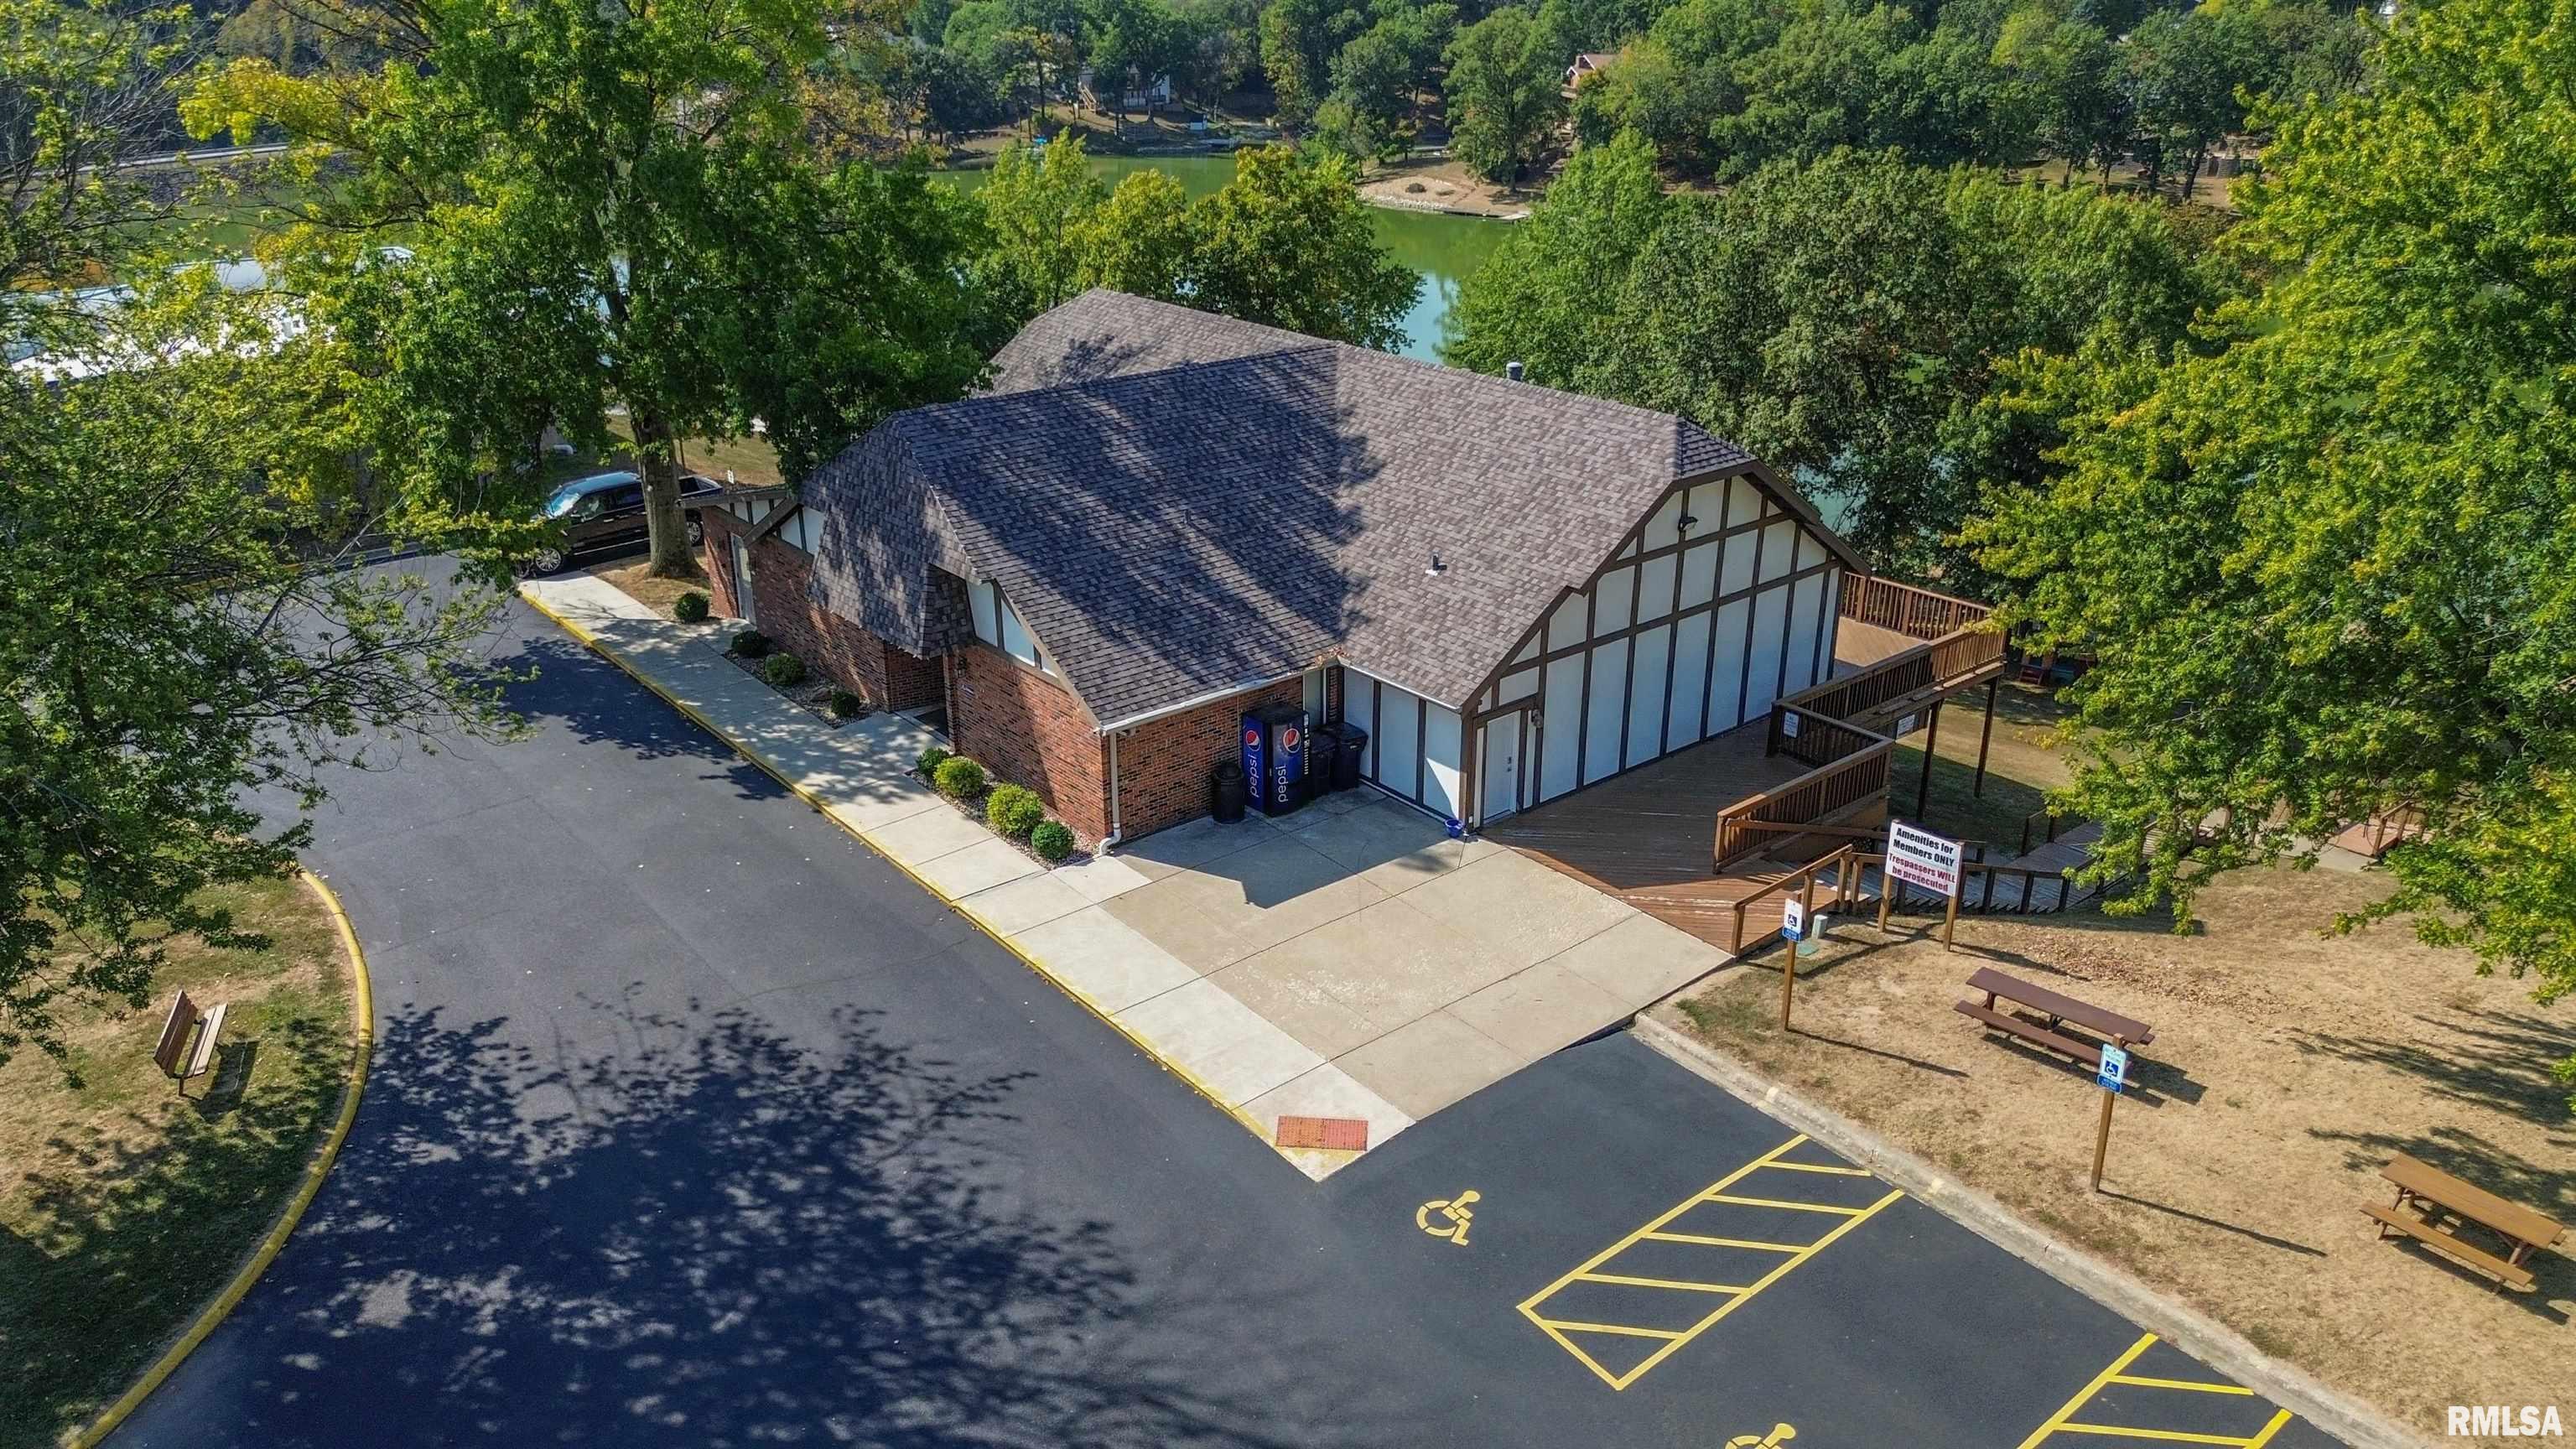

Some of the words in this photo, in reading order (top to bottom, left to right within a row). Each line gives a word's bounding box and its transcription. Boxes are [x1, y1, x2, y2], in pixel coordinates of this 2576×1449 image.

[1248, 754, 1259, 798] pepsi
[1275, 764, 1289, 803] pepsi
[1893, 839, 1933, 860] Members
[1934, 853, 1955, 867] ONLY
[1897, 828, 1940, 849] Amenities
[1940, 843, 1954, 854] for
[1889, 853, 1936, 876] Trespassers
[1937, 870, 1955, 883] WILL
[1892, 865, 1903, 875] be
[1903, 870, 1949, 892] prosecuted
